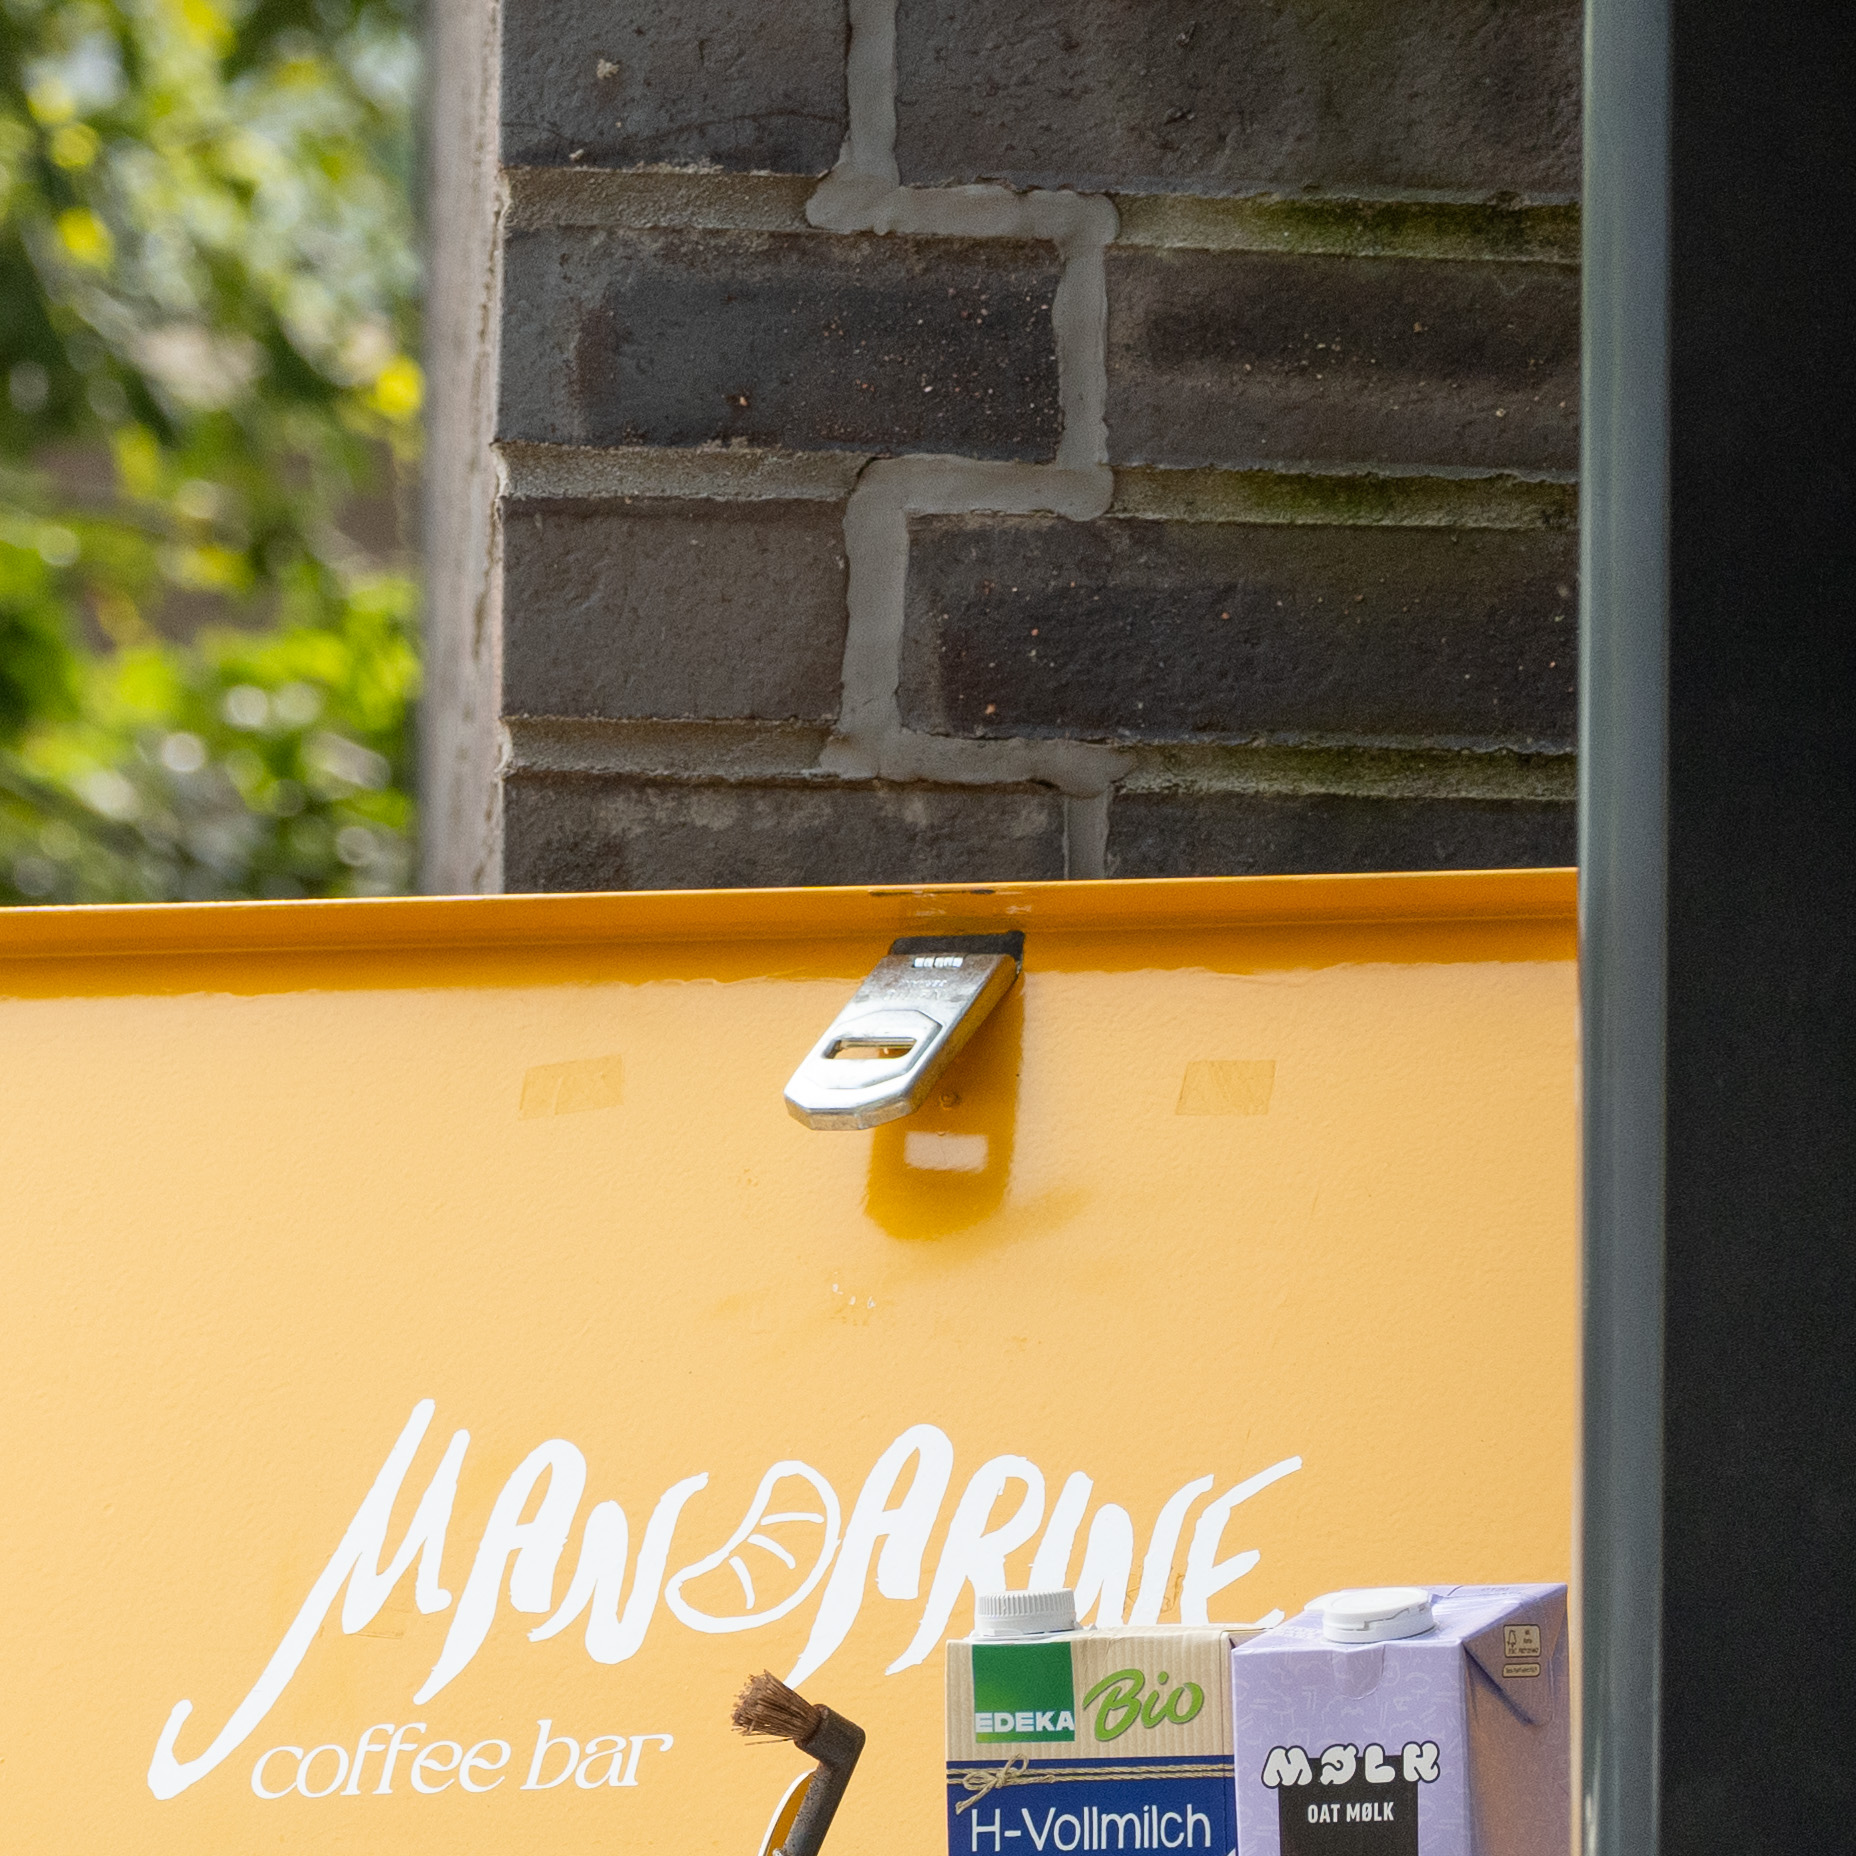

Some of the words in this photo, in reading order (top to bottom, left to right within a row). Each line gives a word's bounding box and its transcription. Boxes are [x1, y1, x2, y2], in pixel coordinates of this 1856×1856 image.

[975, 1711, 1075, 1733] EDEKA
[1083, 1668, 1204, 1741] Bio
[250, 1721, 511, 1799] coffee
[521, 1719, 674, 1792] bar
[1261, 1741, 1441, 1789] MØLK
[971, 1804, 1211, 1852] H-Vollmilch
[1307, 1804, 1340, 1824] OAT
[1346, 1801, 1395, 1822] MØLK
